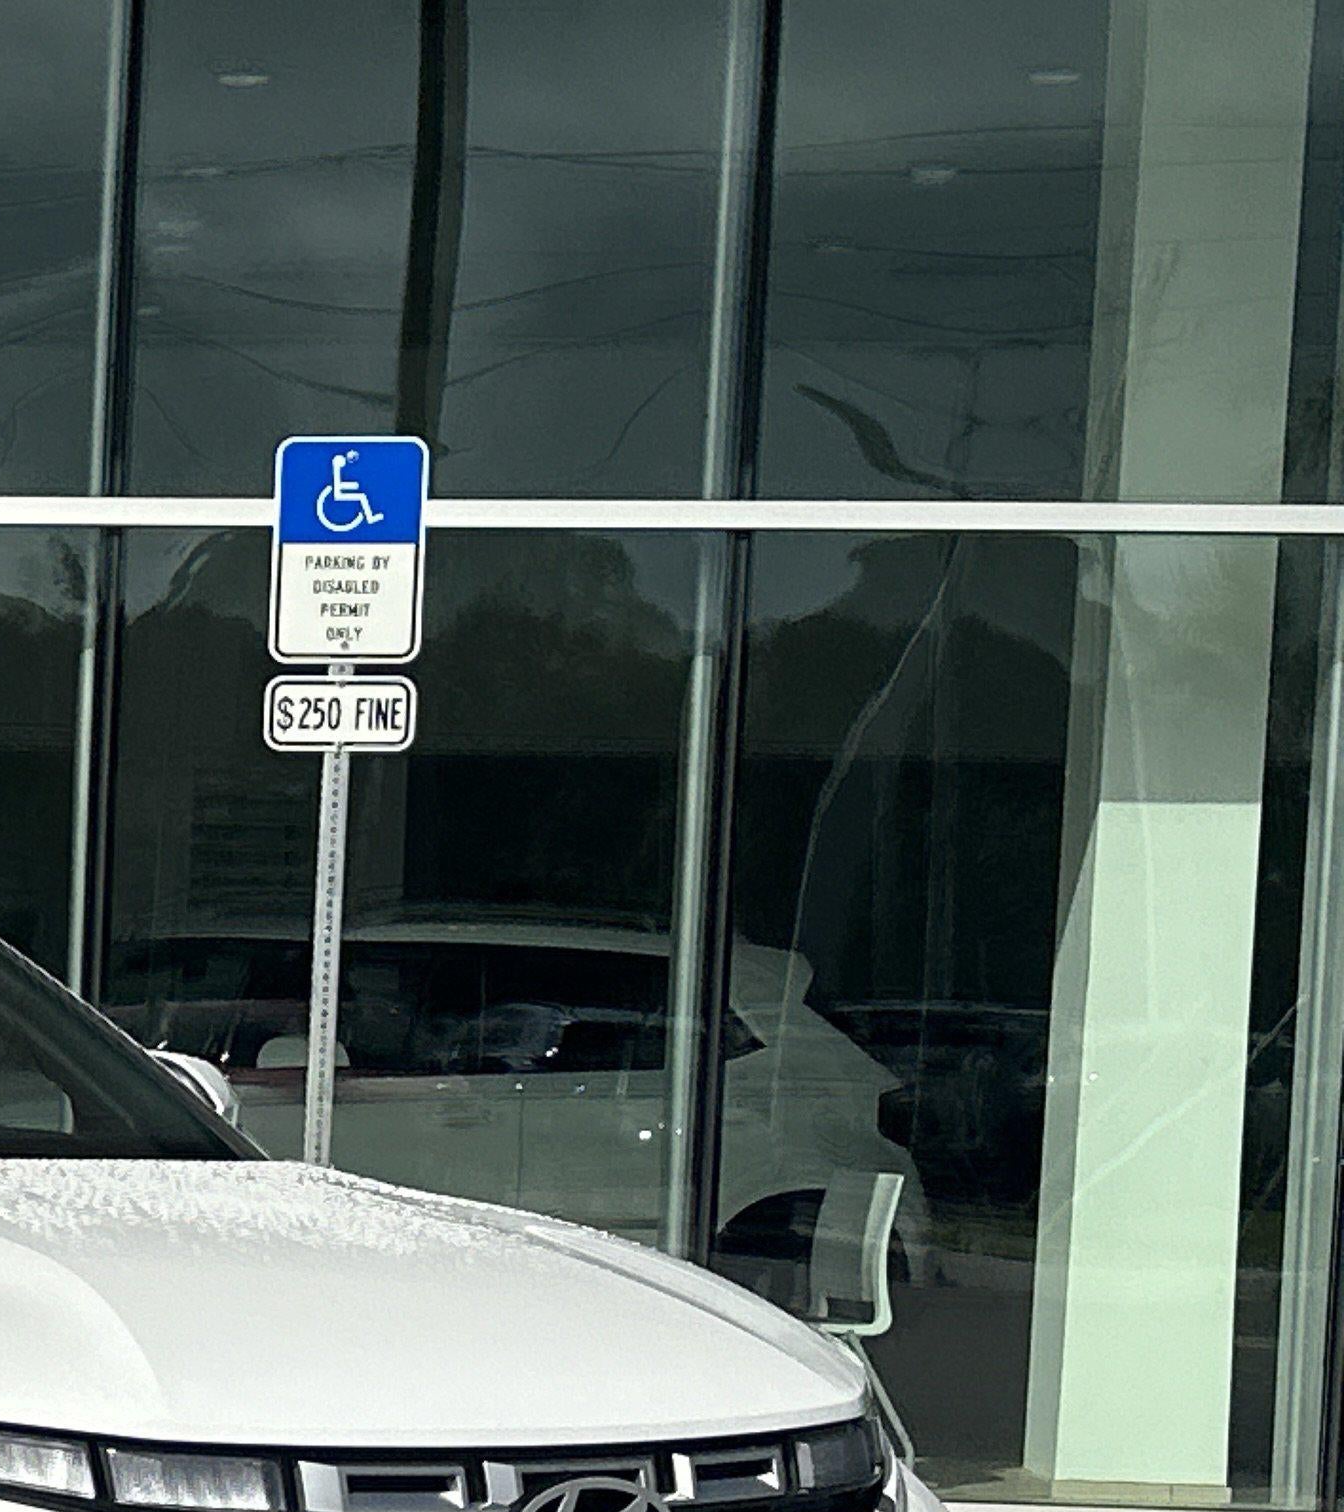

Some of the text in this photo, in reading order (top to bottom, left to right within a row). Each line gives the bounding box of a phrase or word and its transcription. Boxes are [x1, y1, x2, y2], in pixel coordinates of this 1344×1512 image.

[304, 555, 391, 570] PARKING BY
[313, 580, 380, 595] DISABLED
[320, 602, 370, 617] PERMIT
[325, 626, 364, 641] ONLY
[276, 696, 403, 732] $250 FINE
